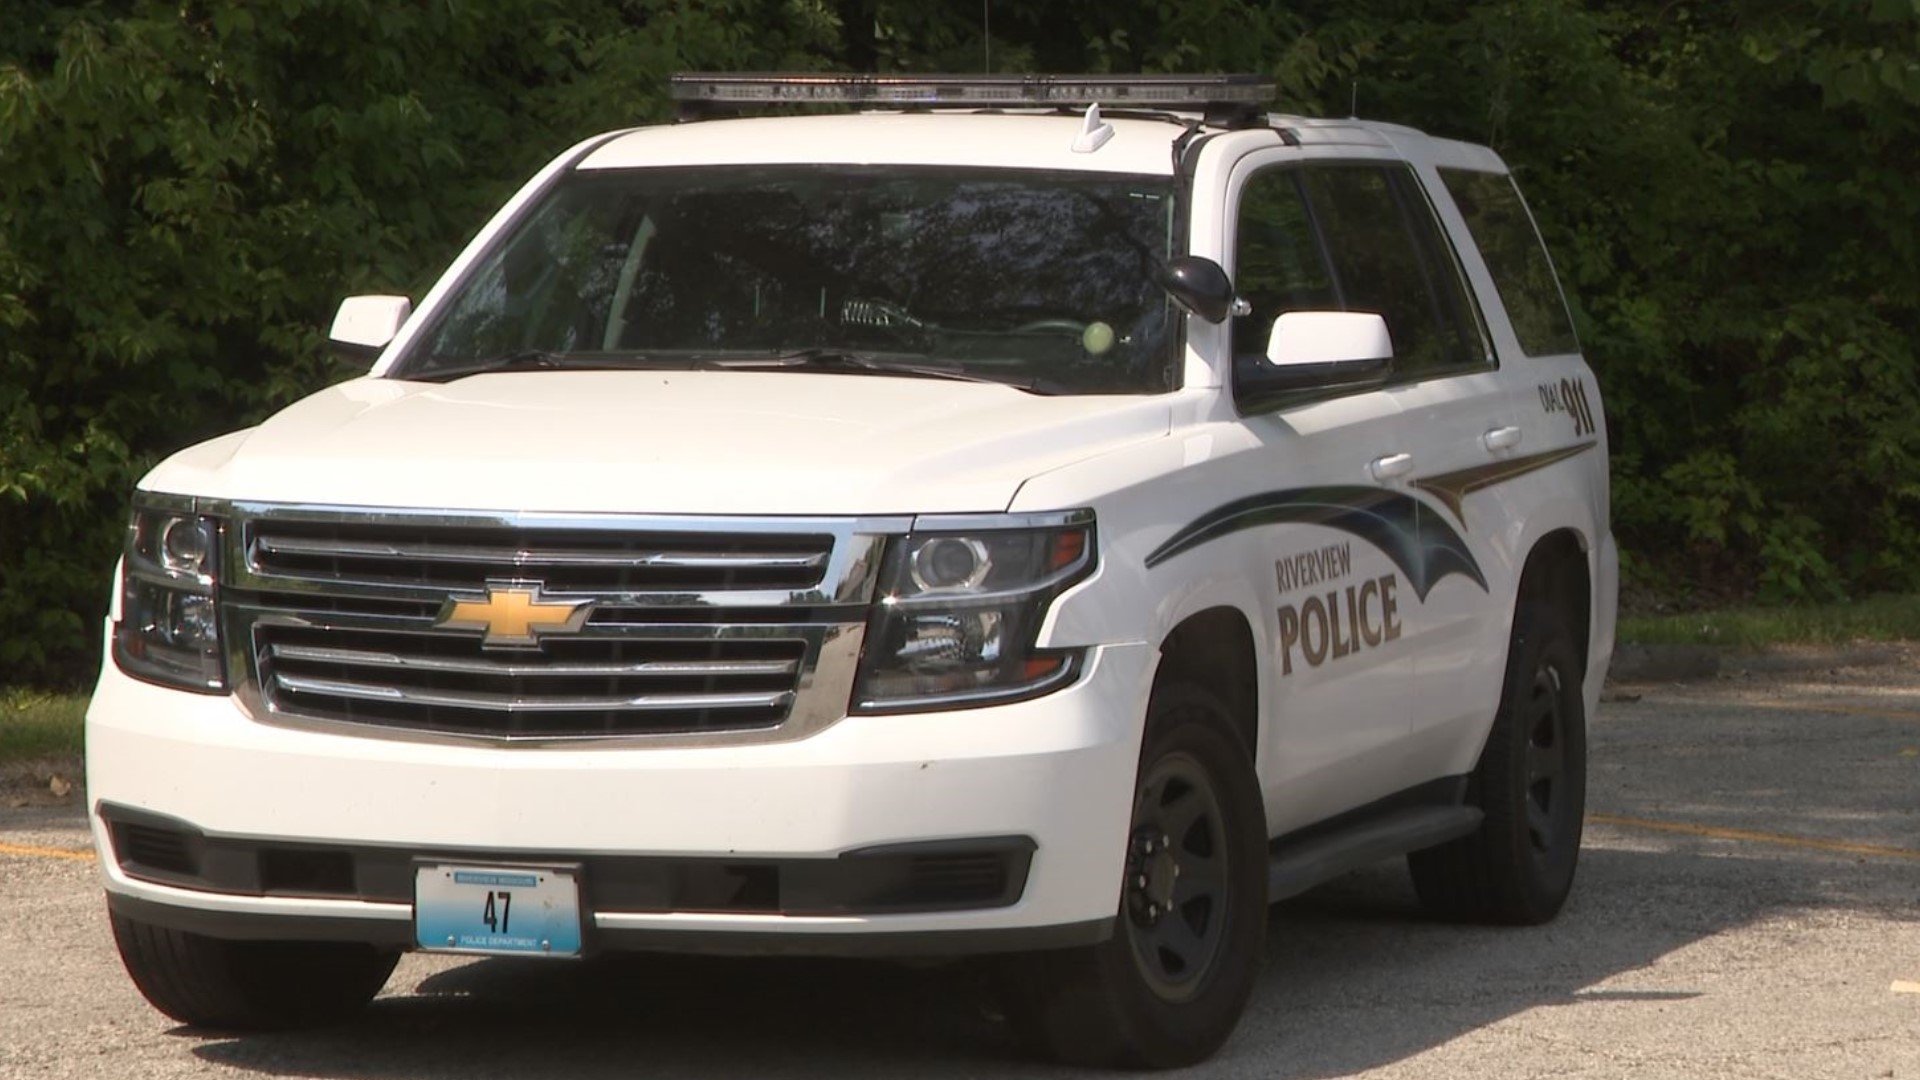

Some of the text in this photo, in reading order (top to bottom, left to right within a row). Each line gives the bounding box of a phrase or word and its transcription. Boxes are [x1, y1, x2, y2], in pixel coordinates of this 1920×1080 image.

[1538, 378, 1595, 436] DIAL 911
[1275, 541, 1351, 594] RIVERVIEW
[1277, 573, 1401, 676] POLICE
[483, 890, 511, 934] 47
[460, 935, 538, 947] POLICE DEPARTMENT
